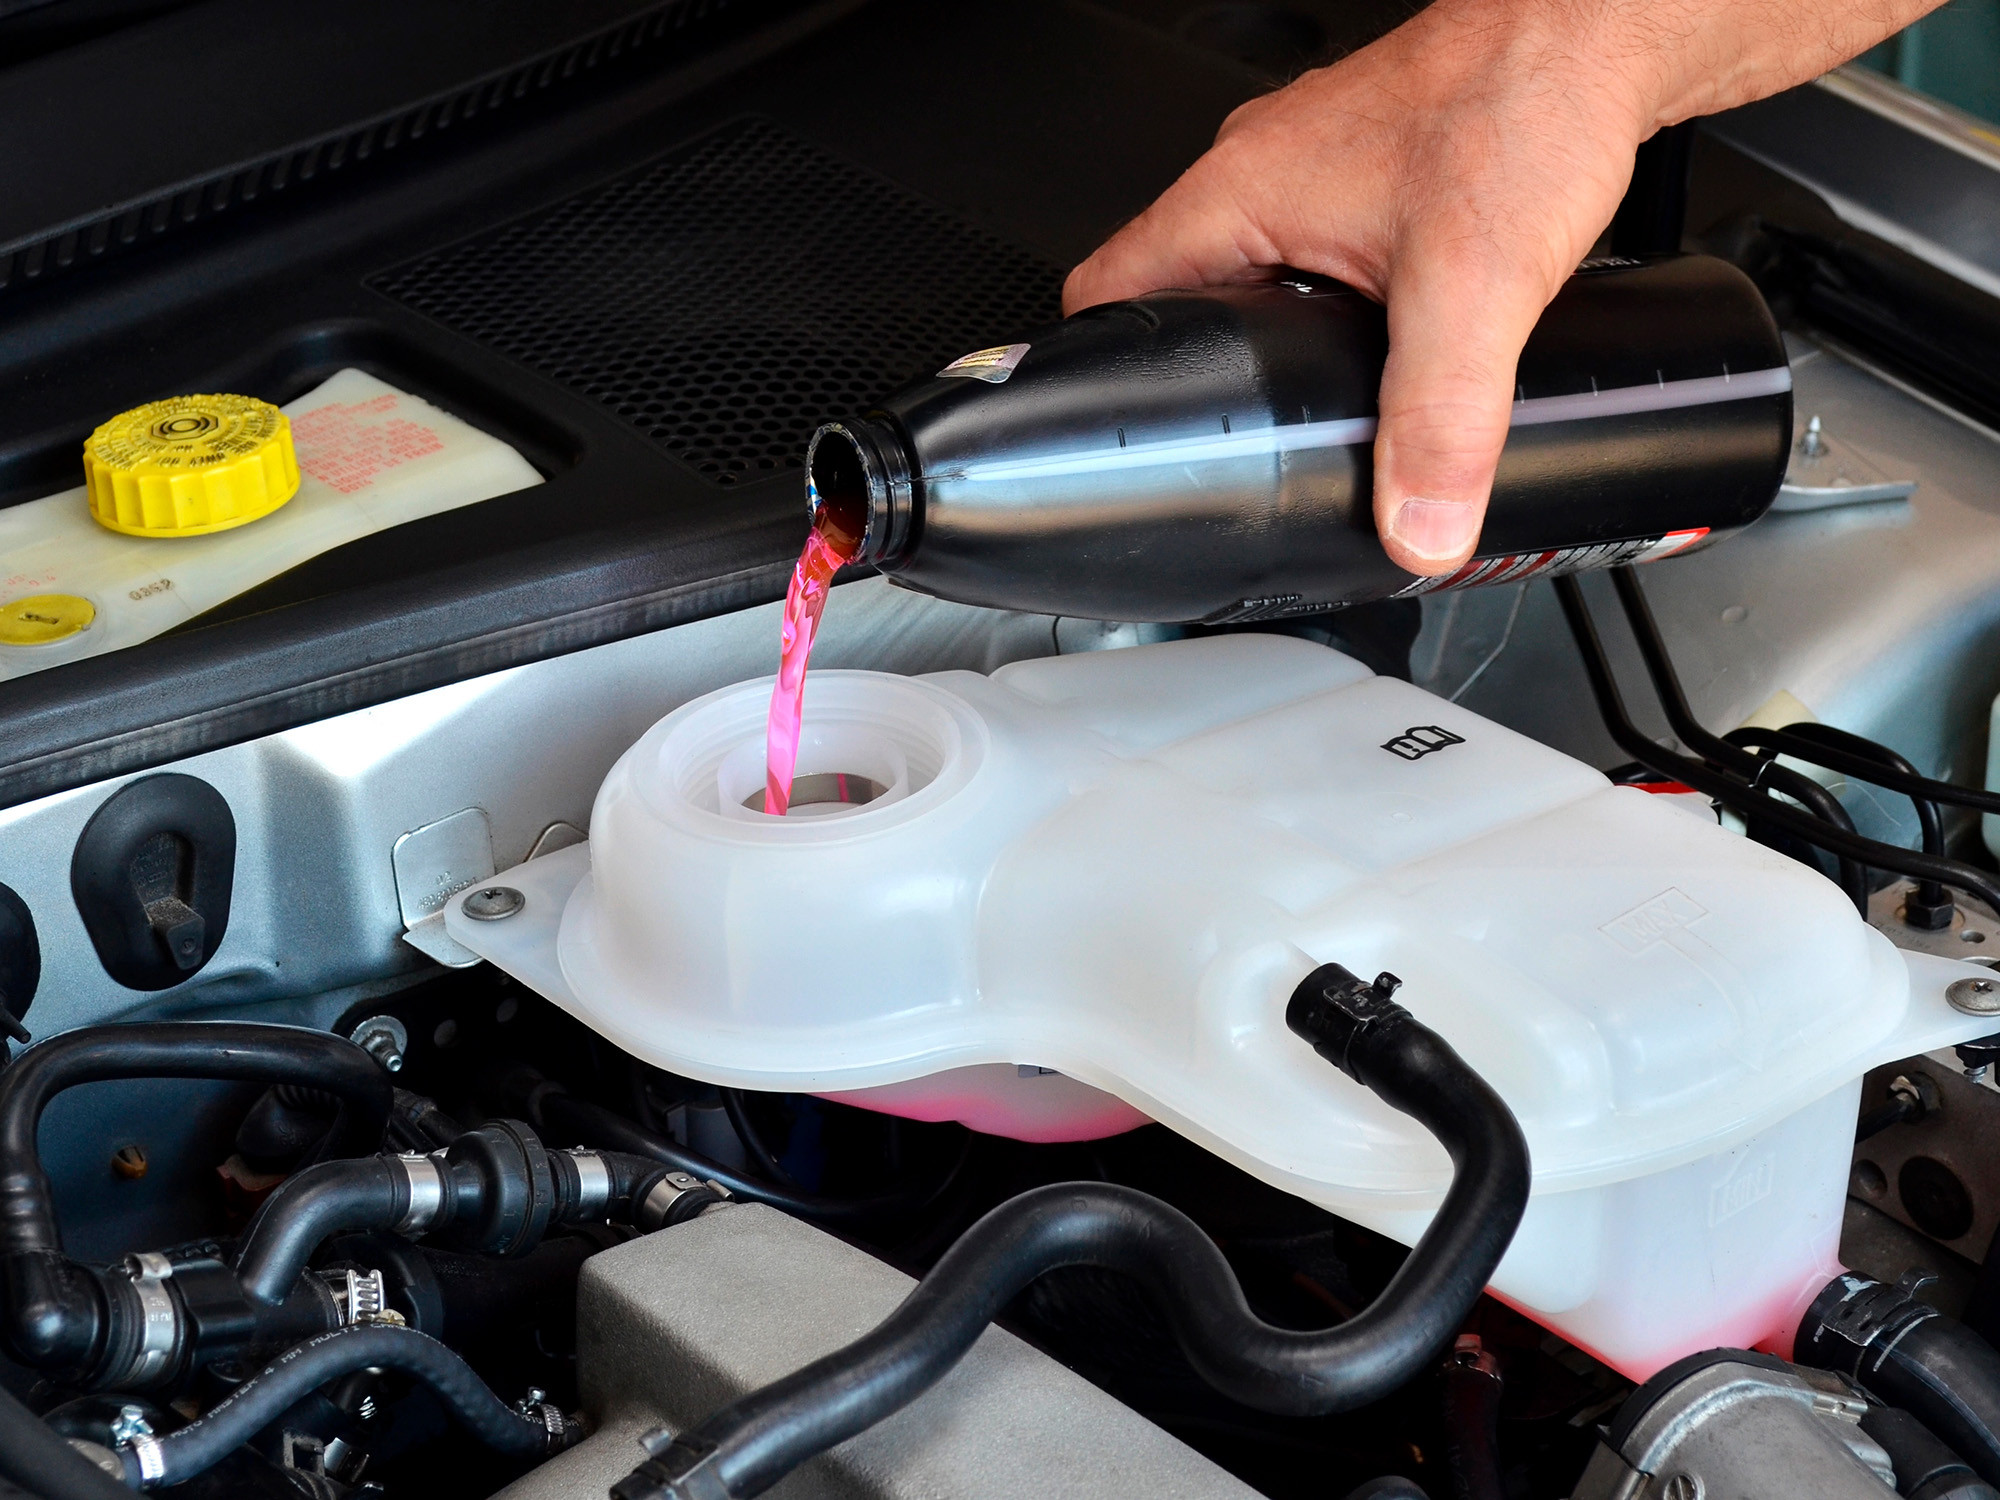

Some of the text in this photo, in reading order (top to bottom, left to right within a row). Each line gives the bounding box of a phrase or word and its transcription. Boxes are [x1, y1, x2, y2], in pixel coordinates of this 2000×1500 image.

[1620, 898, 1688, 943] MAX
[169, 1420, 203, 1439] AUTO
[207, 1379, 258, 1418] MASTER
[264, 1366, 276, 1376] 4
[280, 1347, 303, 1364] MM
[309, 1325, 360, 1347] MULTI
